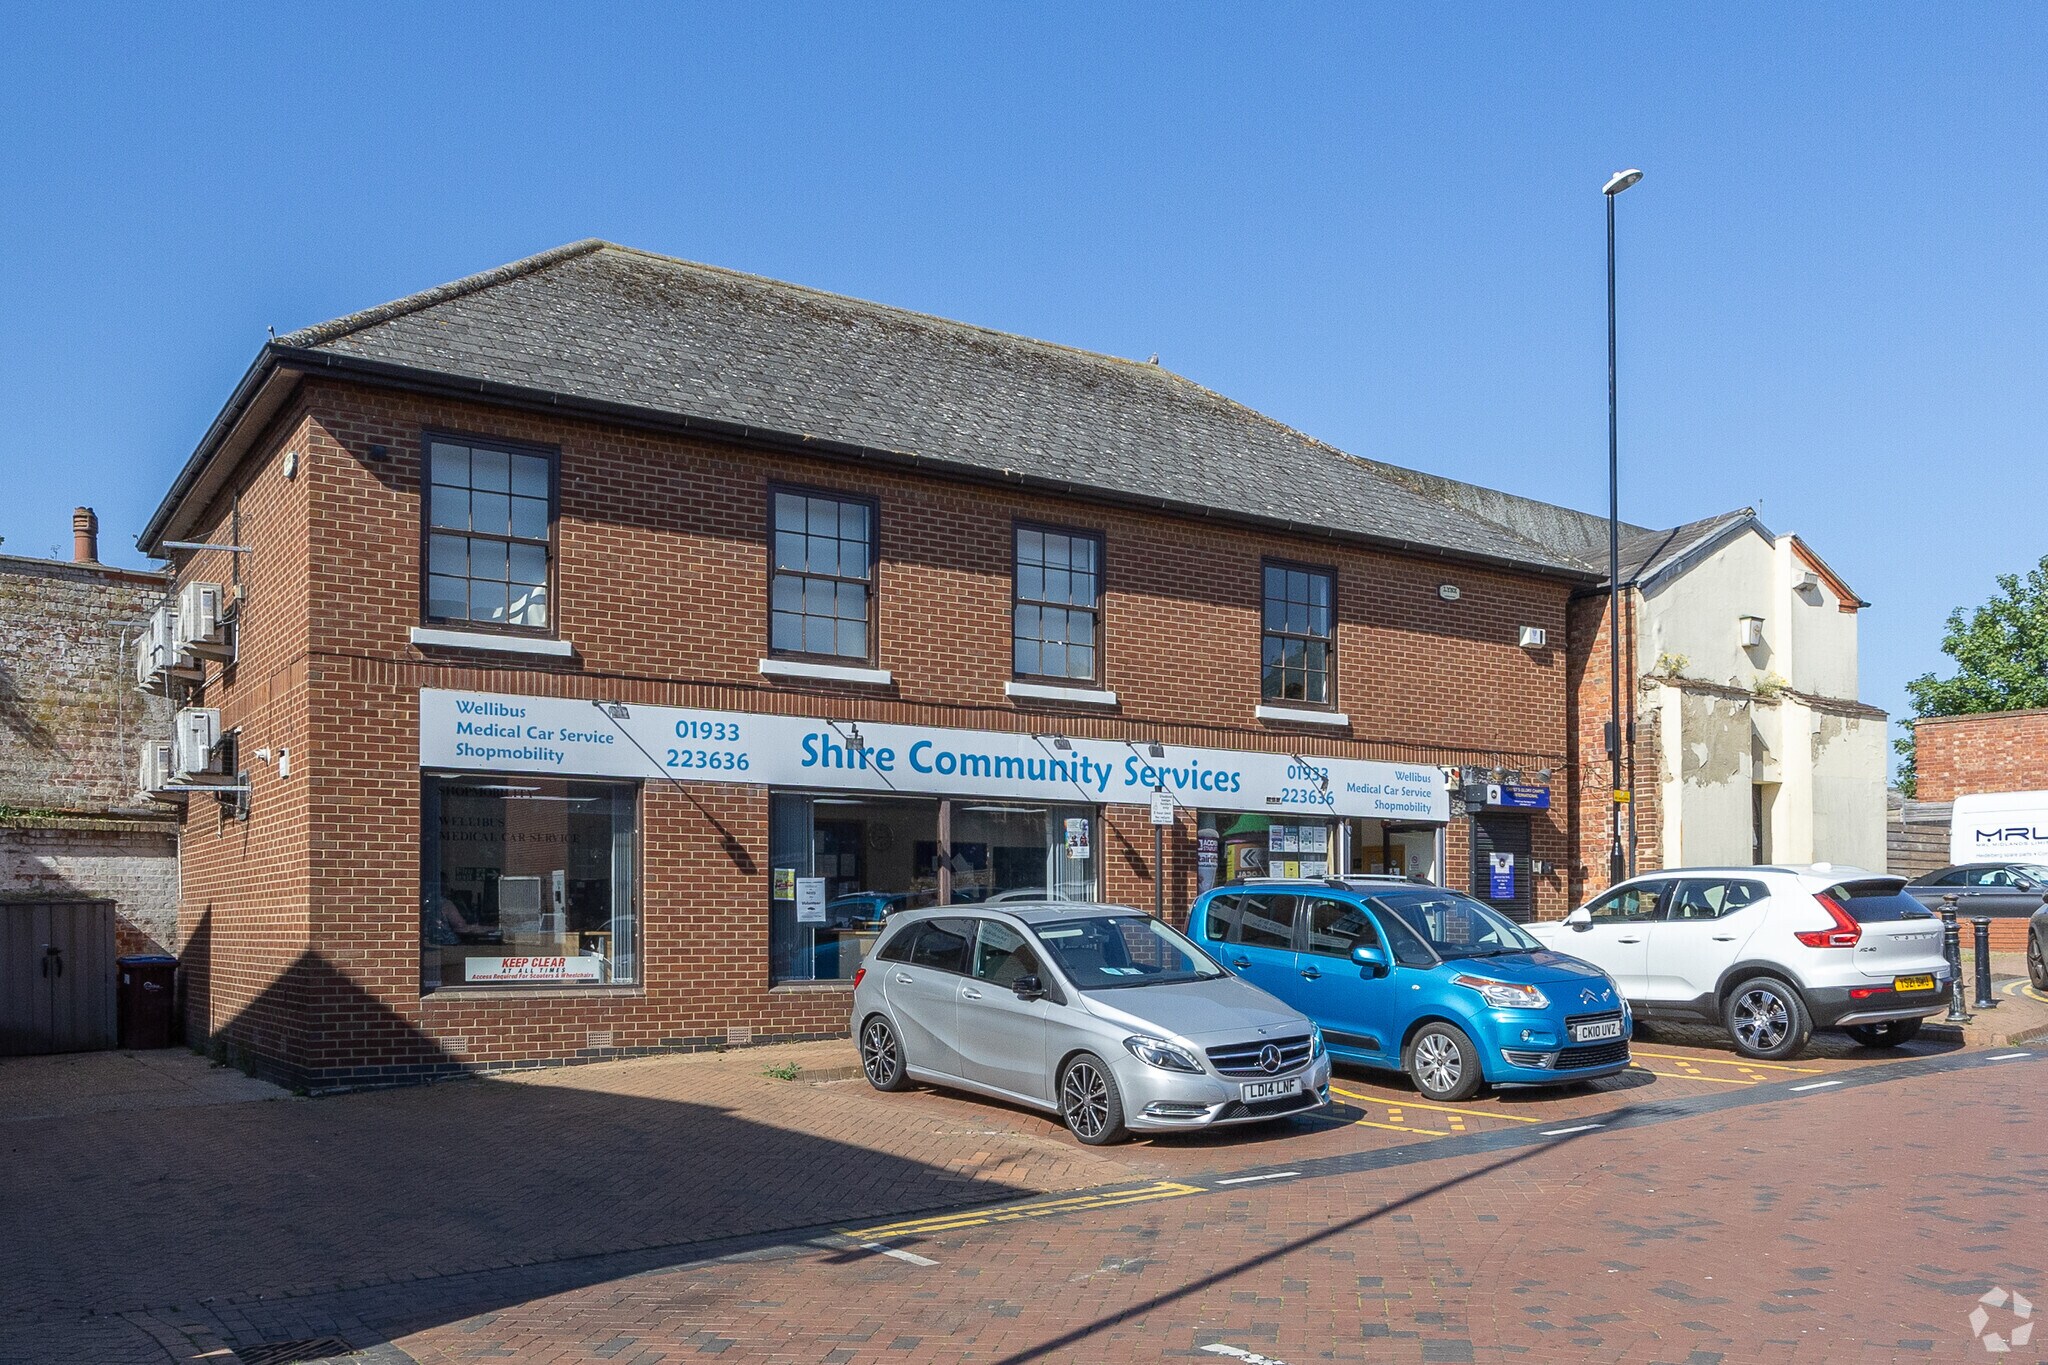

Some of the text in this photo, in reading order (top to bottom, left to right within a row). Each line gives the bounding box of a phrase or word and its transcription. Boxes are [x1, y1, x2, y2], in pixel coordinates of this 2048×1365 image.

[456, 700, 526, 718] Wellibus
[456, 721, 614, 744] Medical Car Service
[675, 720, 740, 742] 01933
[456, 743, 564, 764] Shopmobility
[667, 749, 750, 771] 223636
[801, 733, 1241, 793] Shire Community Services
[1287, 765, 1329, 782] 01933
[1395, 770, 1431, 783] Wellibus
[1281, 788, 1335, 806] 223636
[1346, 783, 1432, 798] Medical Car Service
[1374, 800, 1432, 815] Shopmobility
[440, 831, 581, 844] MEDICAL CAR SERVICE
[1976, 827, 2048, 842] MRL
[502, 957, 566, 968] KEEP CLEAR
[1602, 1024, 1616, 1036] UVZ
[1250, 1080, 1295, 1098] LD14 LNF
